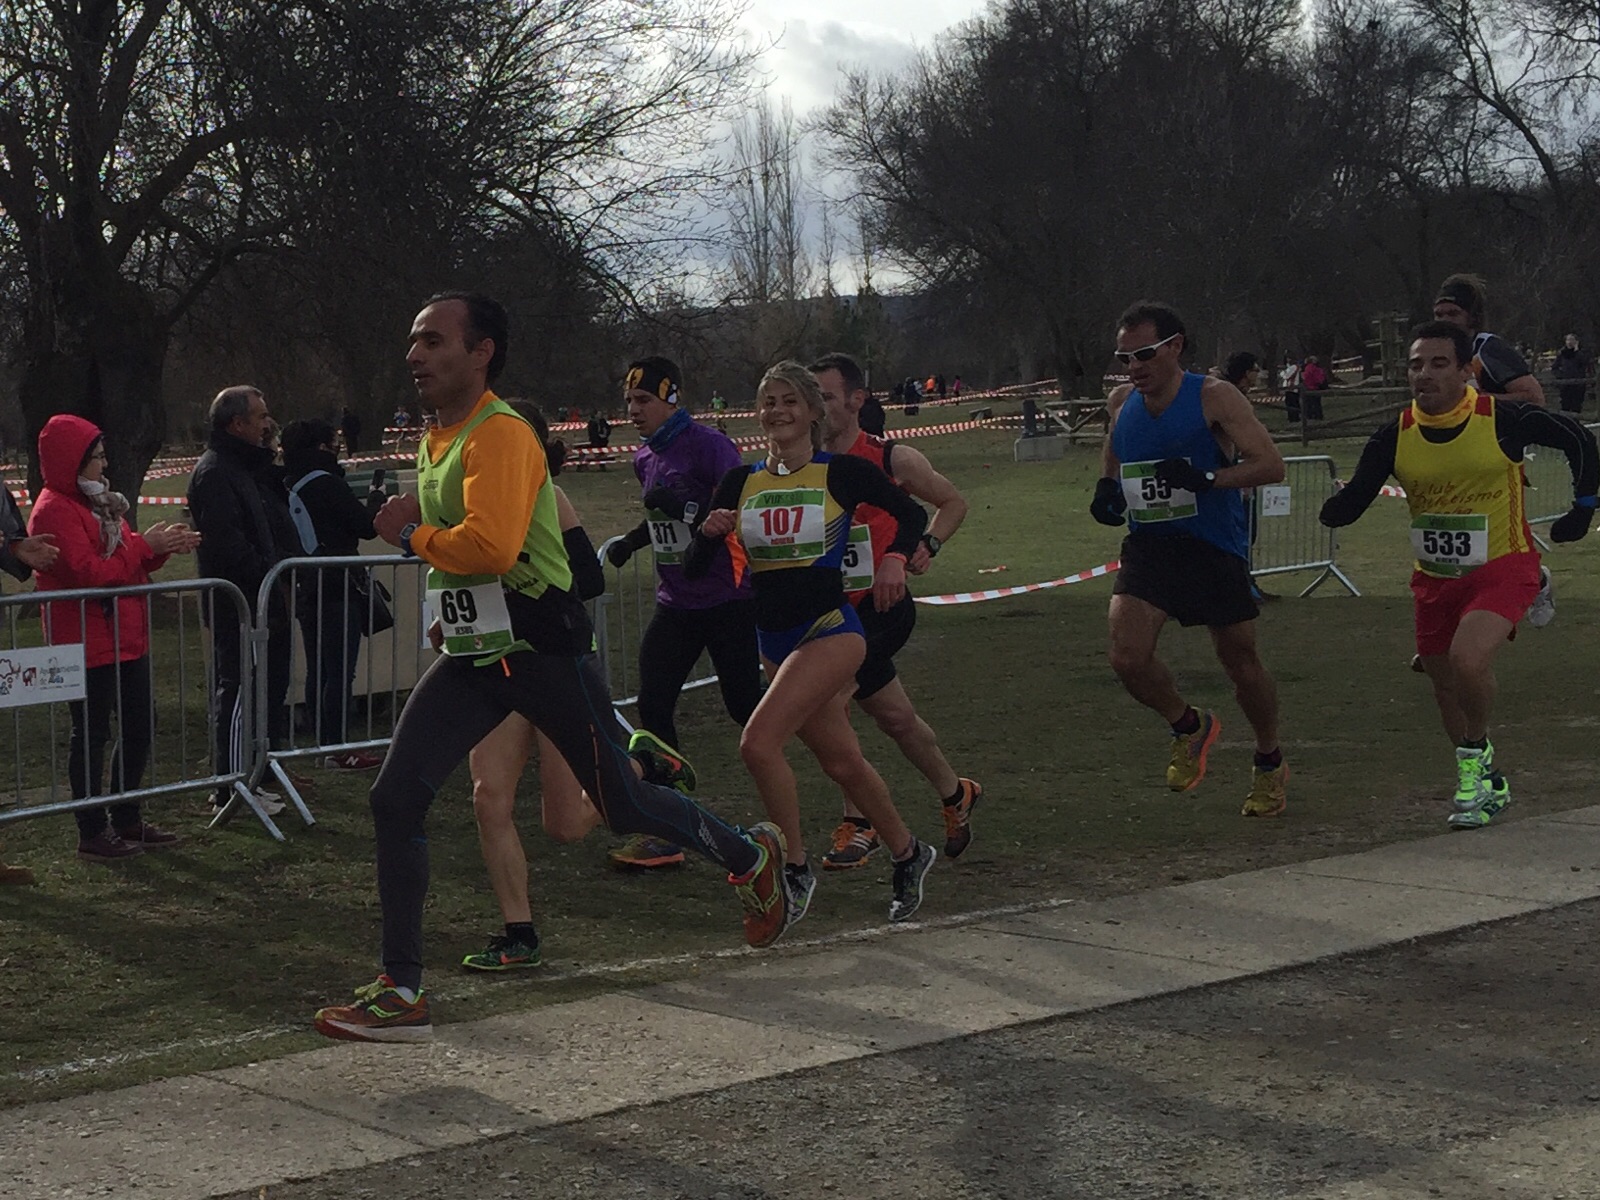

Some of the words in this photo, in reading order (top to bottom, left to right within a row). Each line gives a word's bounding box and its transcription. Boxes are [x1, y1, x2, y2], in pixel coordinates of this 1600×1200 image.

[1141, 478, 1172, 502] 55
[652, 522, 678, 545] 371
[758, 506, 804, 537] 107
[1423, 530, 1471, 557] 533
[441, 588, 477, 625] 69
